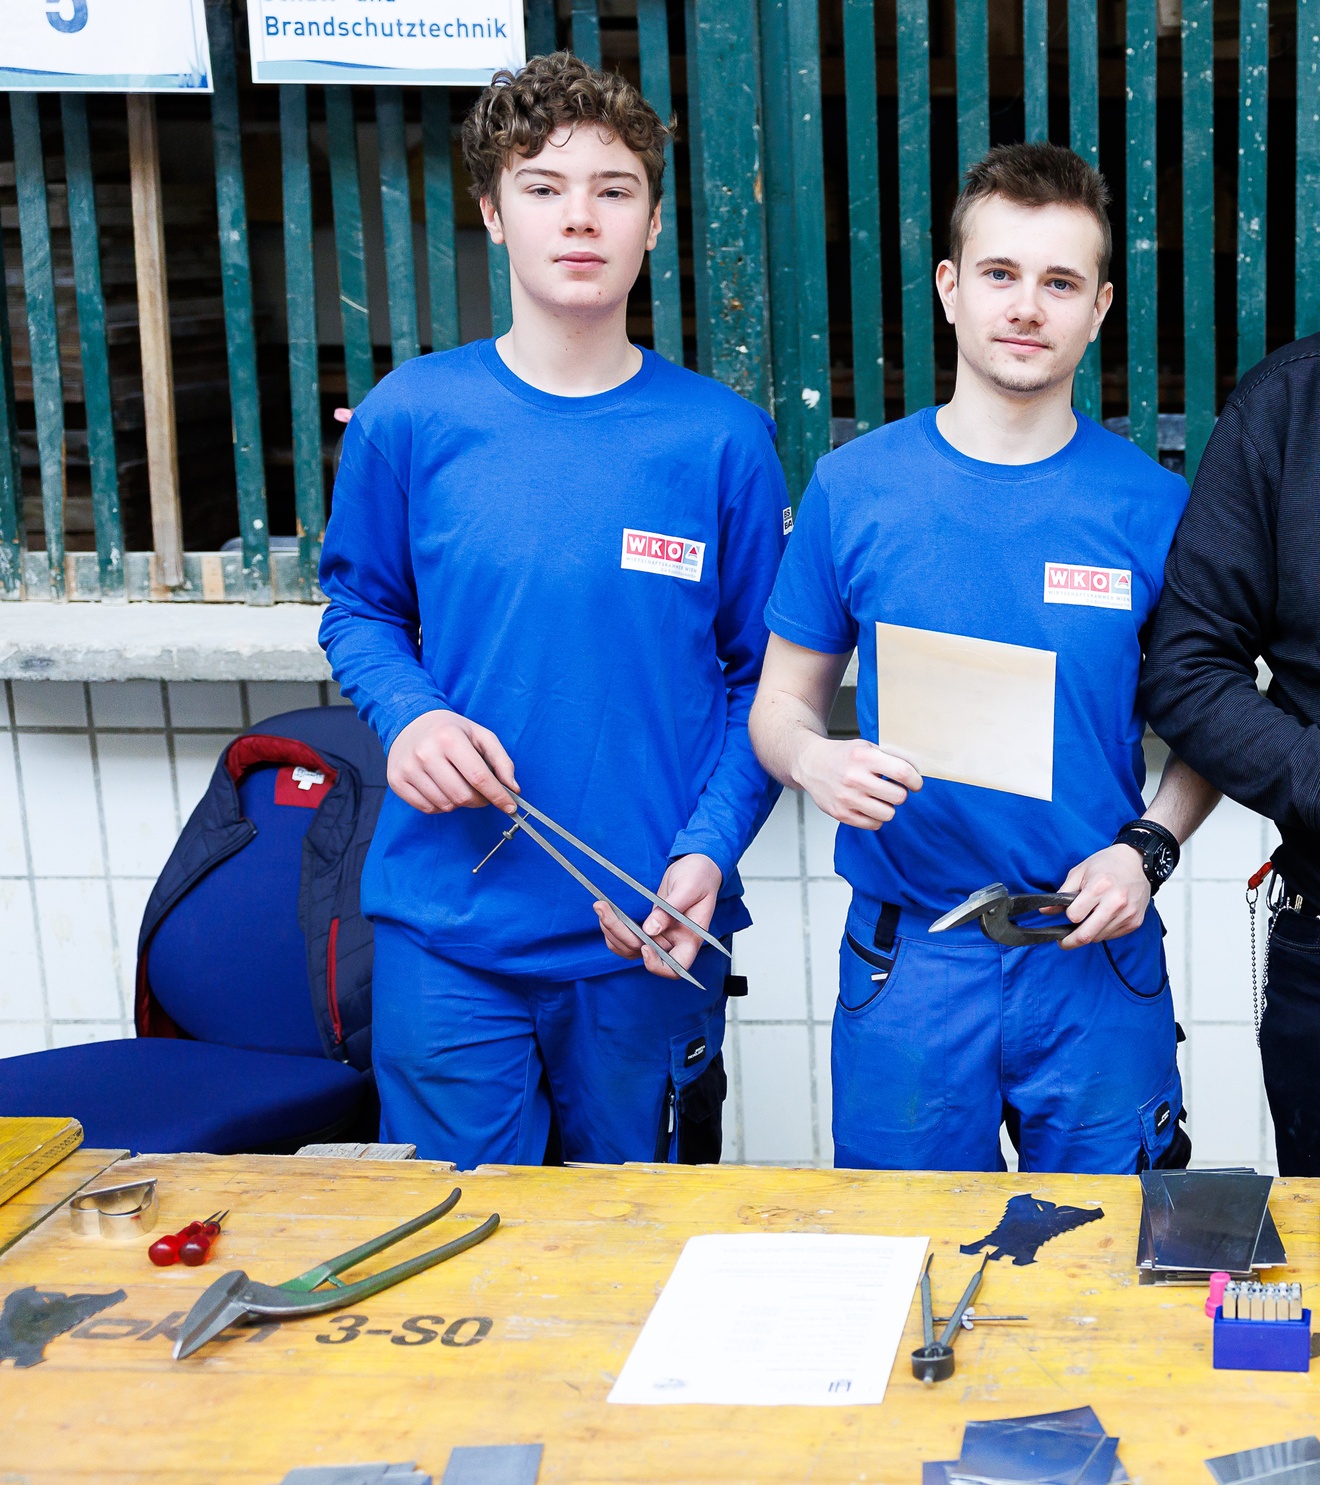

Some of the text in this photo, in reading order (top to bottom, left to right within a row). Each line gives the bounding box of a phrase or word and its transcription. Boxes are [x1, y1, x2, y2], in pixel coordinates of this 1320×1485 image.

[265, 15, 508, 38] Brandschutztechnik
[627, 535, 683, 561] WKO
[1049, 569, 1108, 591] WKO
[1048, 590, 1114, 600] WIRTSCHAFTSKAMMER
[315, 1314, 494, 1347] 3-SO
